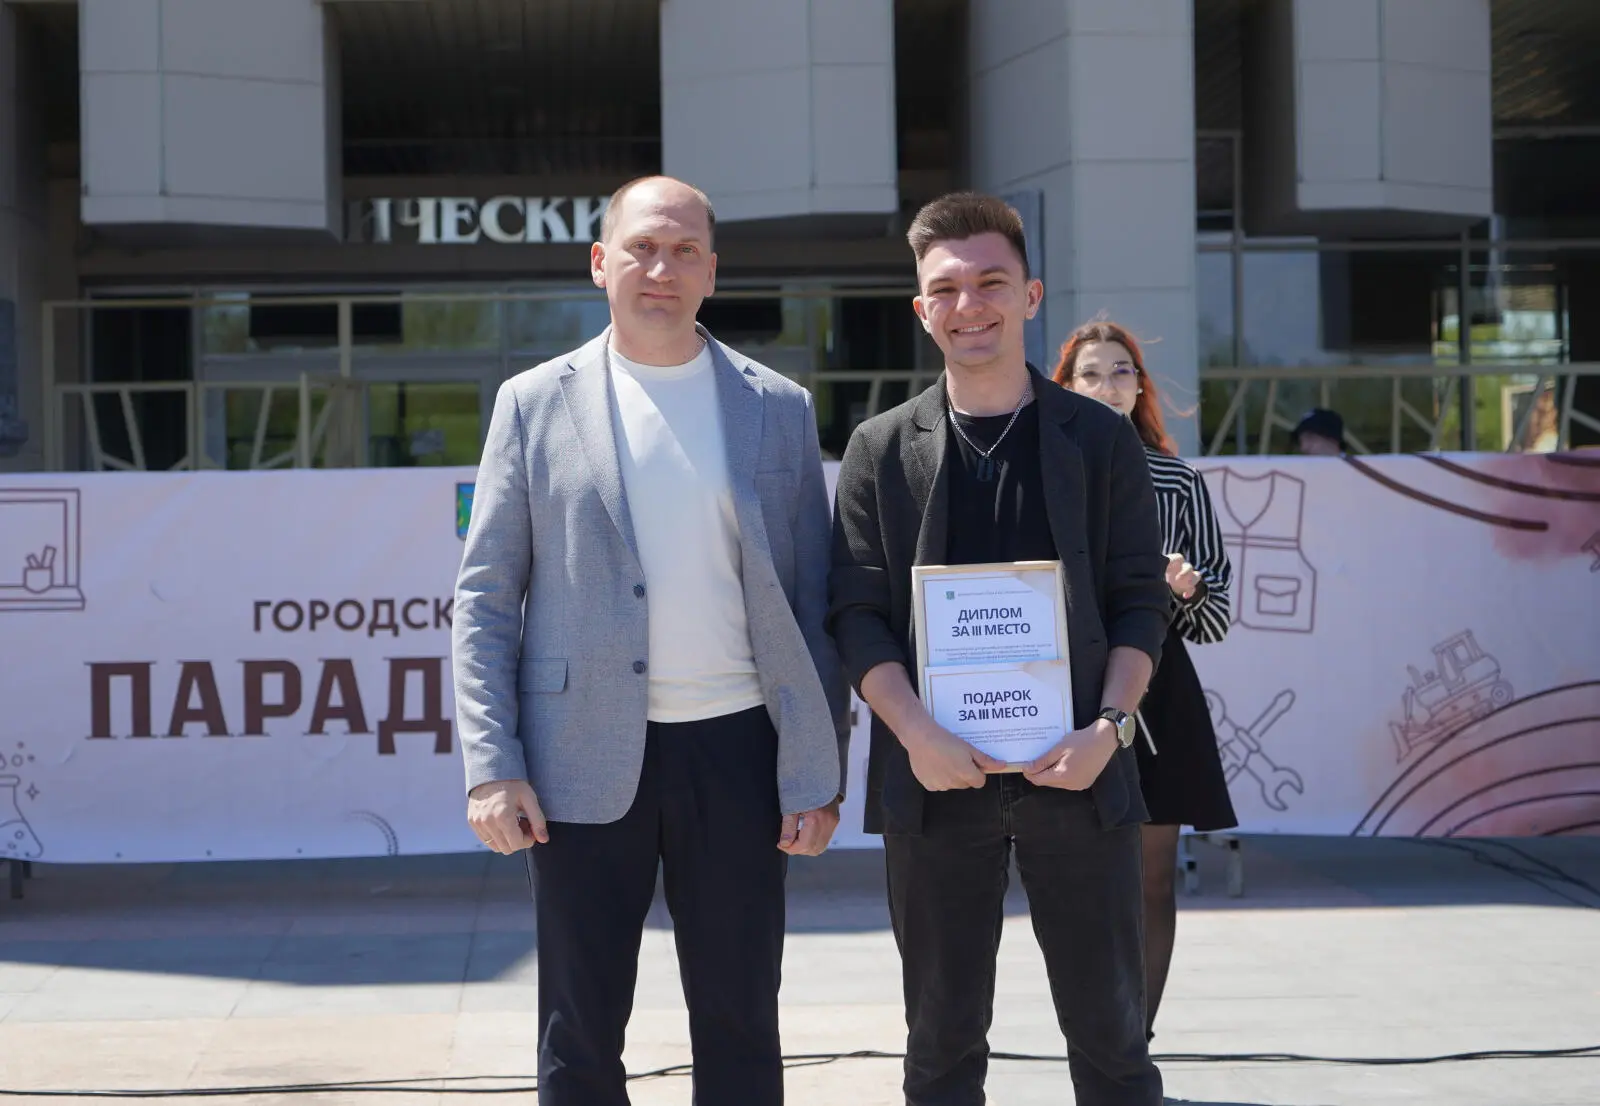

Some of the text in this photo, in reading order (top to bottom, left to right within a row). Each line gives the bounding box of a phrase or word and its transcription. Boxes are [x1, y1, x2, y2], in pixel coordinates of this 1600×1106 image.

[253, 598, 454, 638] ГОРОДСК
[957, 606, 1023, 623] ДИПЛОМ
[951, 622, 1031, 637] ЗА III МЕСТО
[84, 656, 452, 755] ПАРАД
[963, 689, 1032, 706] ПОДАРОК
[958, 705, 1038, 721] ЗА III МЕСТО
